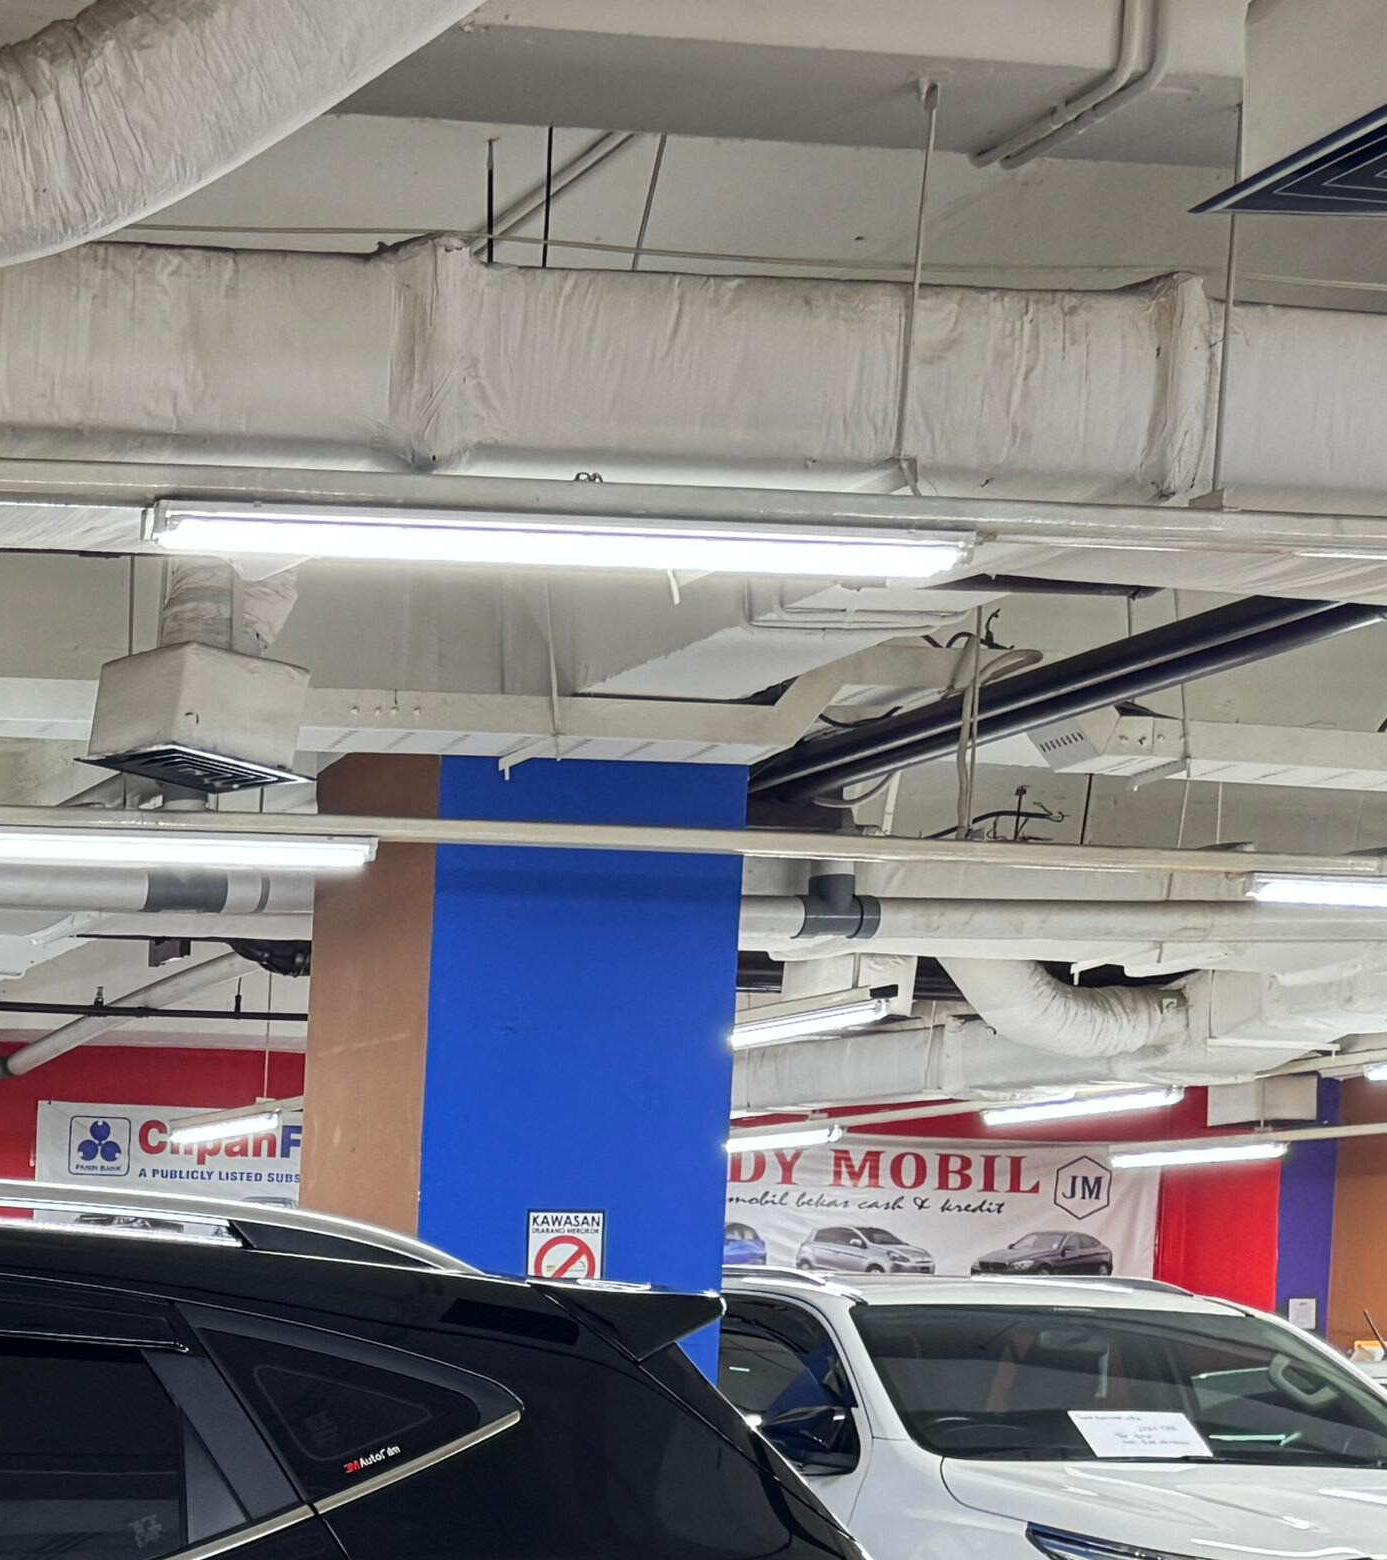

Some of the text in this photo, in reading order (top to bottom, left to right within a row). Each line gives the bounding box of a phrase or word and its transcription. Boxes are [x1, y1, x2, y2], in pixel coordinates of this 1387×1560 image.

[138, 1168, 302, 1184] A PUBLICLY LISTED SUBS
[727, 1148, 1041, 1195] DY MOBIL
[1061, 1174, 1104, 1201] JM
[727, 1190, 789, 1207] mobil
[795, 1191, 850, 1209] bekas
[857, 1192, 905, 1211] cash
[940, 1197, 1006, 1215] kredit
[531, 1214, 601, 1228] KAWASAN
